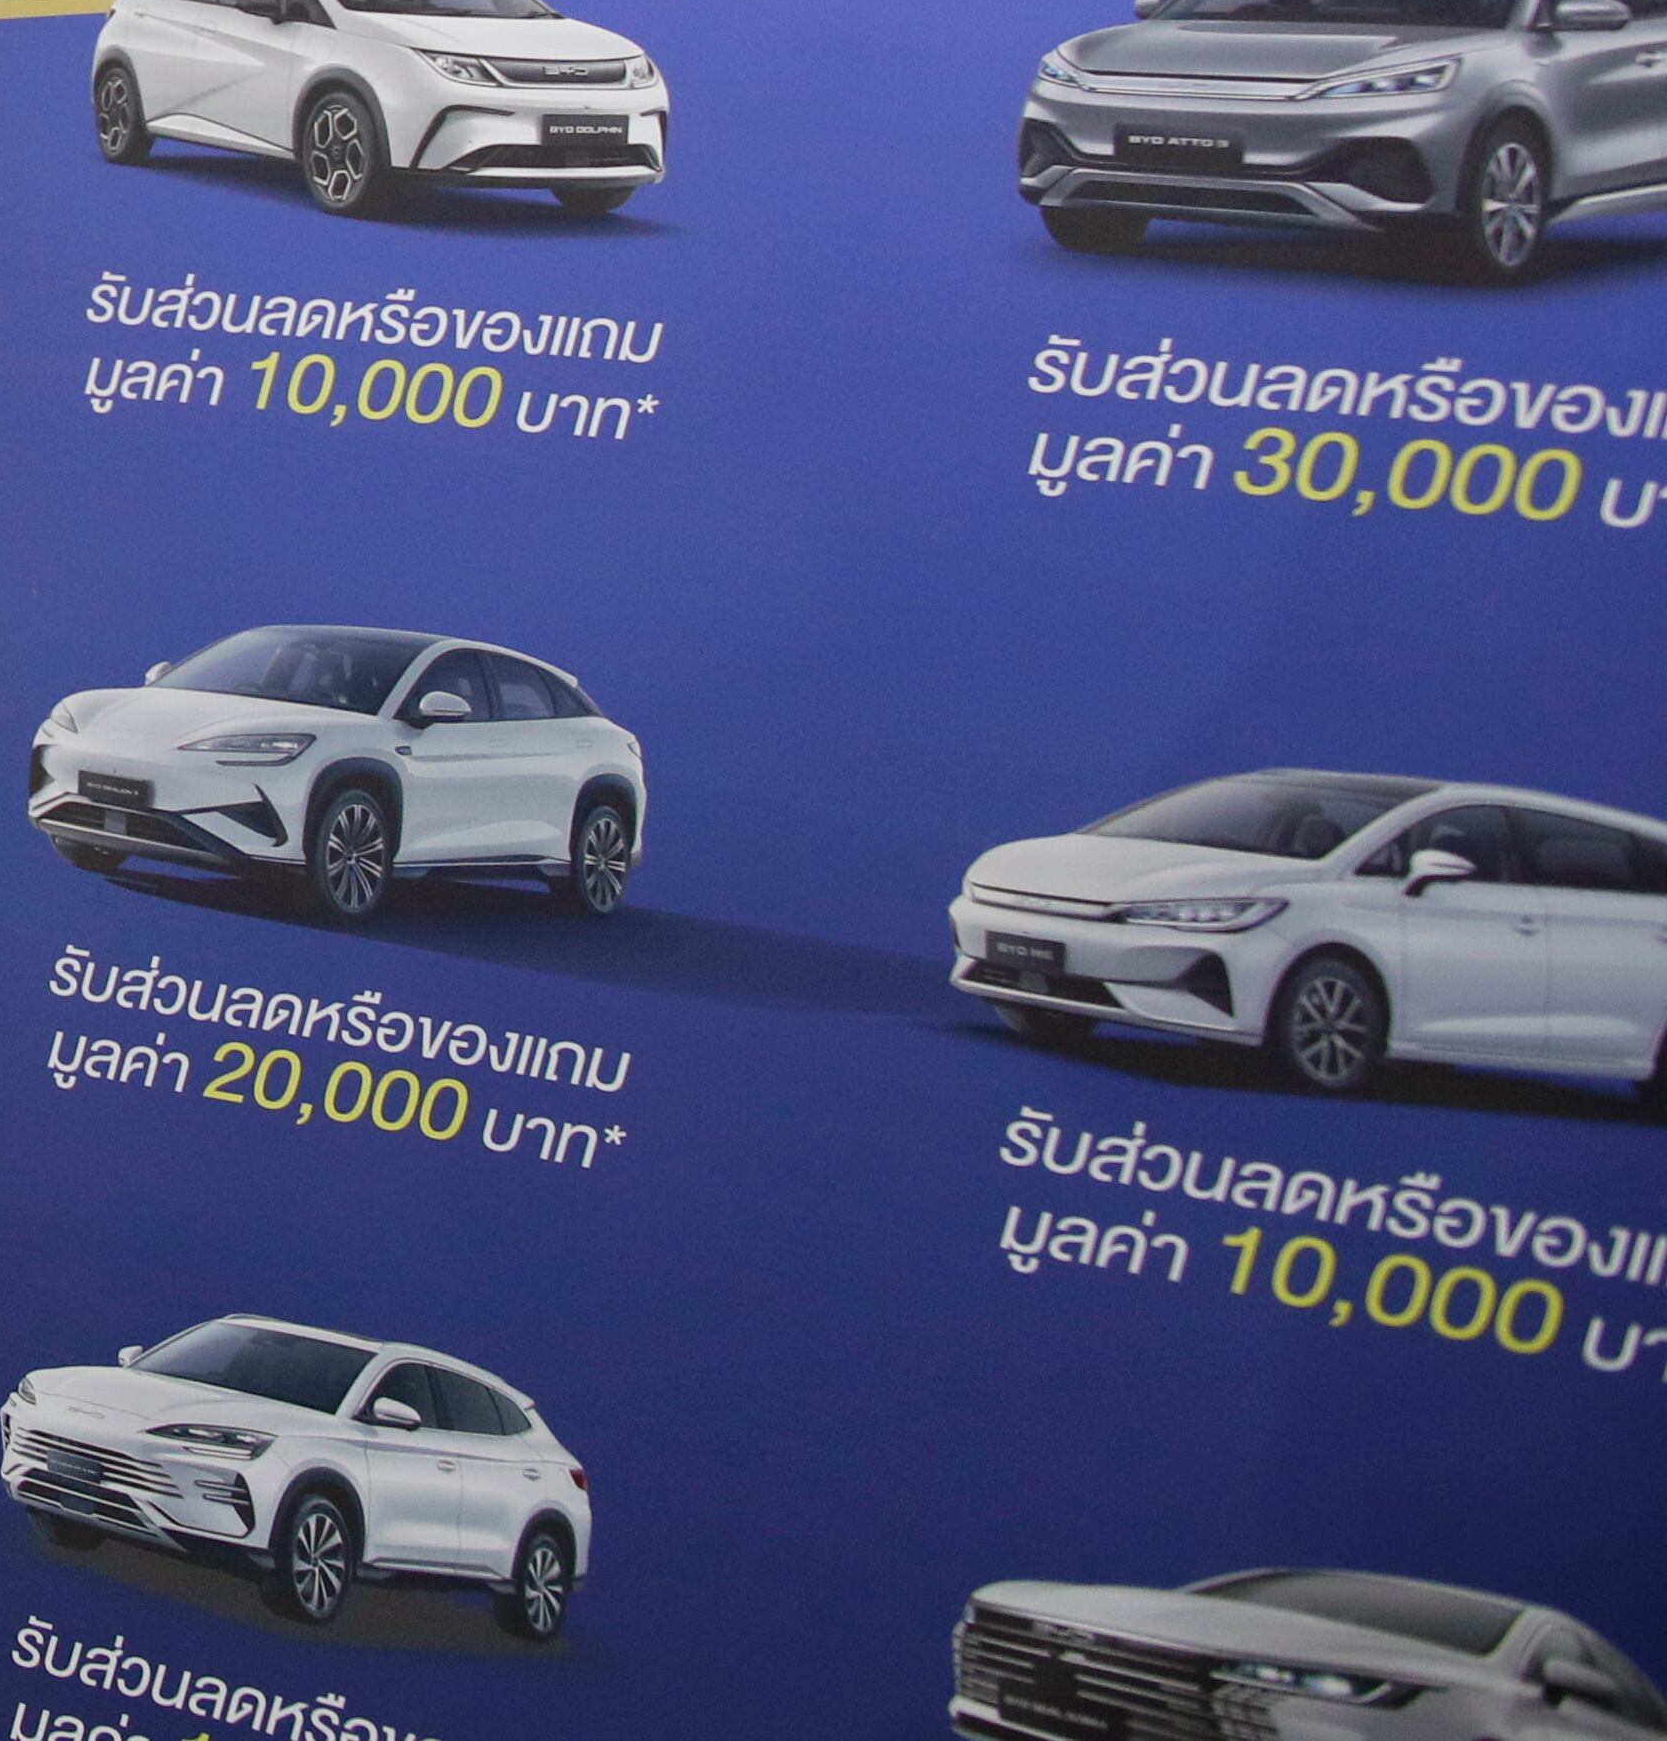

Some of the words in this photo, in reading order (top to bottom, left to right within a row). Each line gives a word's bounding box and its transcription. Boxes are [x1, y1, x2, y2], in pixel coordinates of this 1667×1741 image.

[84, 269, 665, 365] รับส่วนลดหรือของแถม
[84, 348, 224, 416] มูลค่า
[252, 351, 504, 429] 10,000
[1027, 424, 1215, 497] มูลค่า
[1233, 426, 1584, 521] 30,000
[48, 943, 632, 1094] รับส่วนลดหรือของแถม
[47, 1029, 190, 1093] มูลค่า
[202, 1041, 470, 1141] 20,000
[998, 1205, 1190, 1282] มูลค่า
[1222, 1227, 1564, 1354] 10,000
